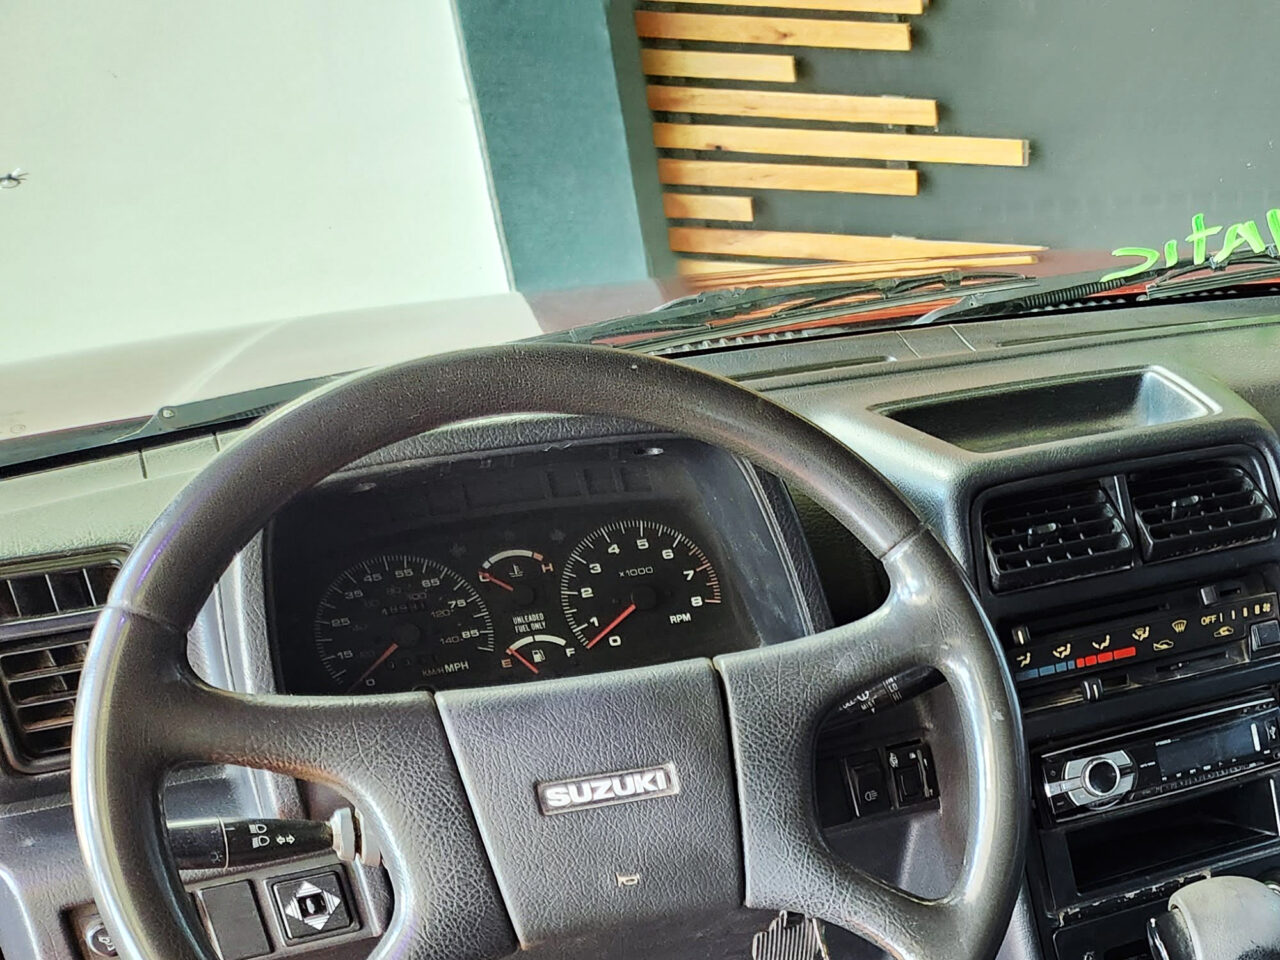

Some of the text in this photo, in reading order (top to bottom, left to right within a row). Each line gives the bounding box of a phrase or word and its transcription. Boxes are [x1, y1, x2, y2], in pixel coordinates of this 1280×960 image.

[607, 543, 620, 555] 4
[636, 538, 649, 550] 5
[661, 548, 674, 560] 6
[395, 568, 414, 578] 55
[541, 563, 554, 574] H
[588, 563, 602, 574] 3
[363, 573, 382, 583] 45
[682, 569, 695, 581] 7
[421, 578, 440, 588] 65
[344, 589, 364, 600] 35
[580, 587, 594, 599] 2
[447, 599, 467, 609] 75
[690, 596, 703, 607] 8
[512, 613, 545, 625] UNLEADED
[589, 616, 600, 628] 1
[669, 612, 692, 625] RPM
[1200, 614, 1217, 626] OFF
[514, 621, 547, 634] FUEL ONLY
[461, 629, 480, 639] 85
[608, 635, 622, 647] 0
[337, 649, 353, 660] 15
[565, 647, 576, 658] F
[444, 661, 470, 673] MPH
[501, 658, 513, 668] E
[545, 769, 668, 808] SUZUKI
